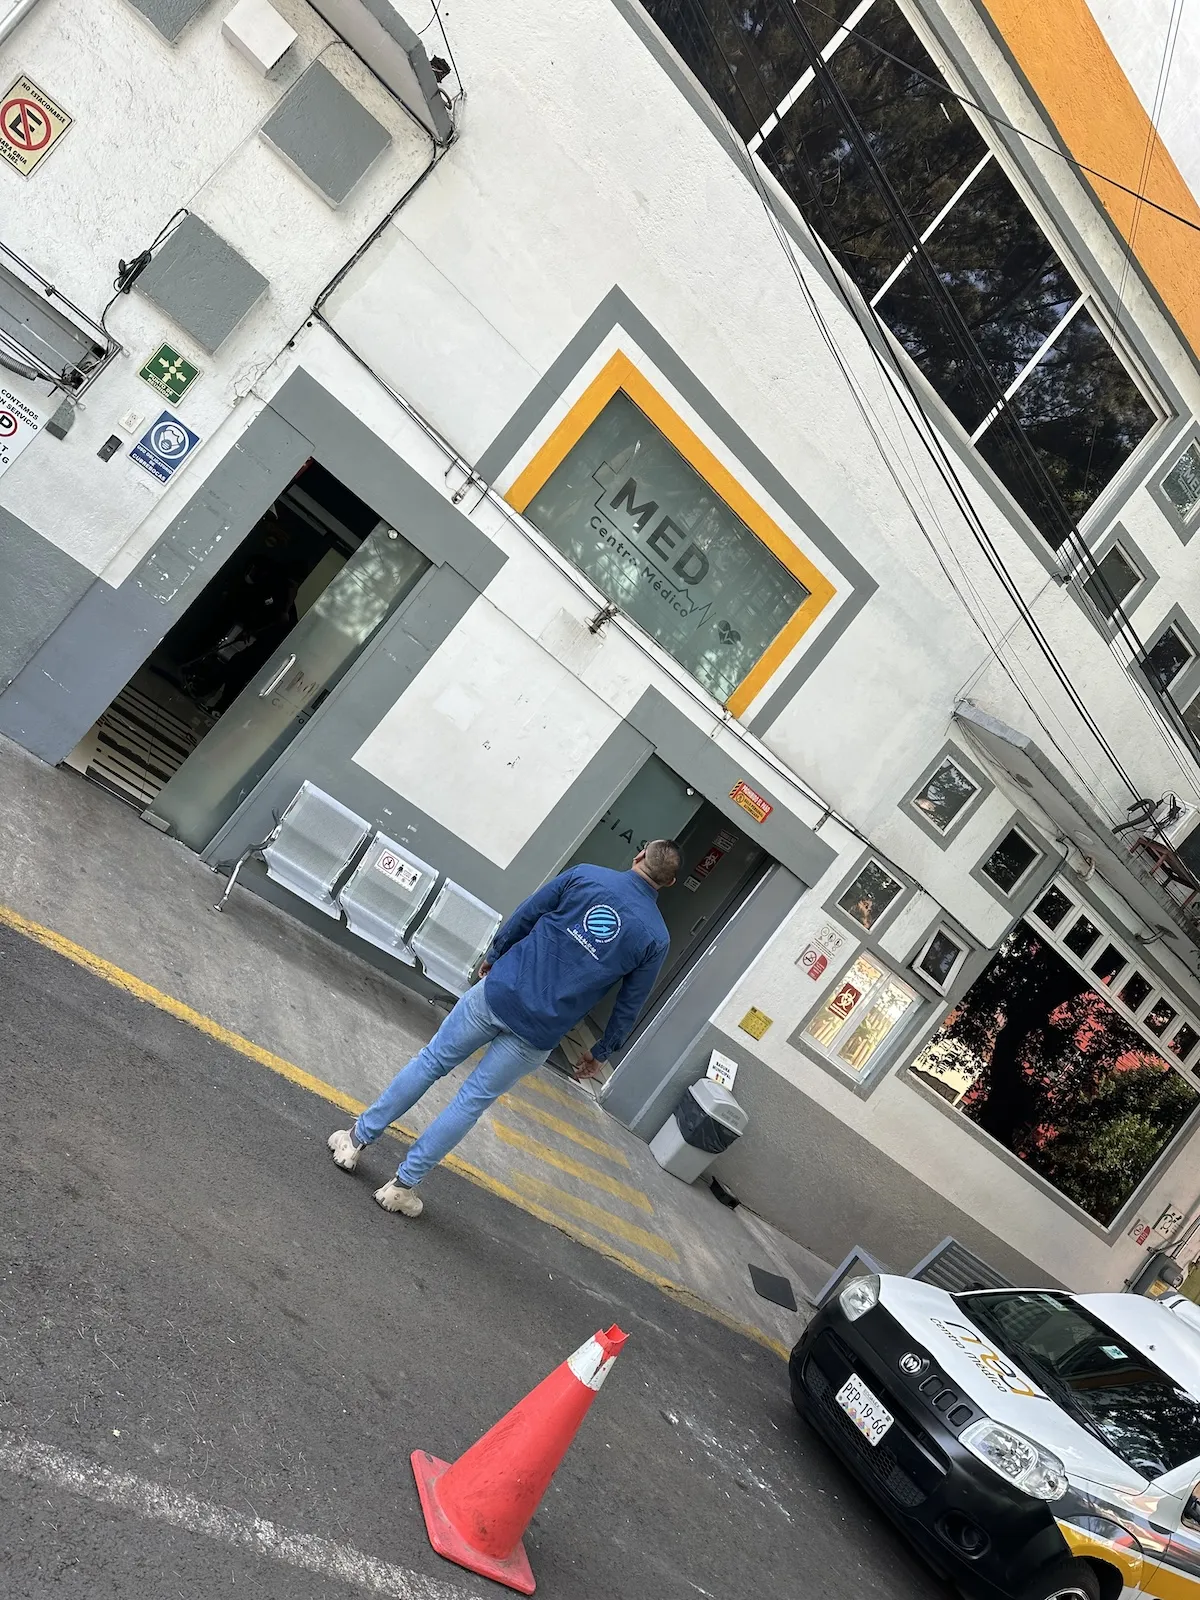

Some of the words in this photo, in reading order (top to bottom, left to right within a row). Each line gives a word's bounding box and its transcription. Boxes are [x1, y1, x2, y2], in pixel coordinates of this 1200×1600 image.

[21, 82, 30, 91] NO
[29, 90, 66, 124] ESTACIONARSE
[13, 150, 28, 165] GRUA
[148, 373, 166, 389] PUNTO
[164, 387, 173, 395] DE
[1, 388, 39, 421] CONTAMOS
[6, 403, 38, 430] SERVICIO
[131, 452, 166, 481] CUBREBOCAS
[136, 444, 147, 453] USO
[145, 451, 173, 474] OBLIGATORIO
[610, 477, 710, 586] MED
[589, 515, 639, 567] Centro
[641, 566, 689, 618] Médico
[842, 1381, 885, 1434] PEP-19-66
